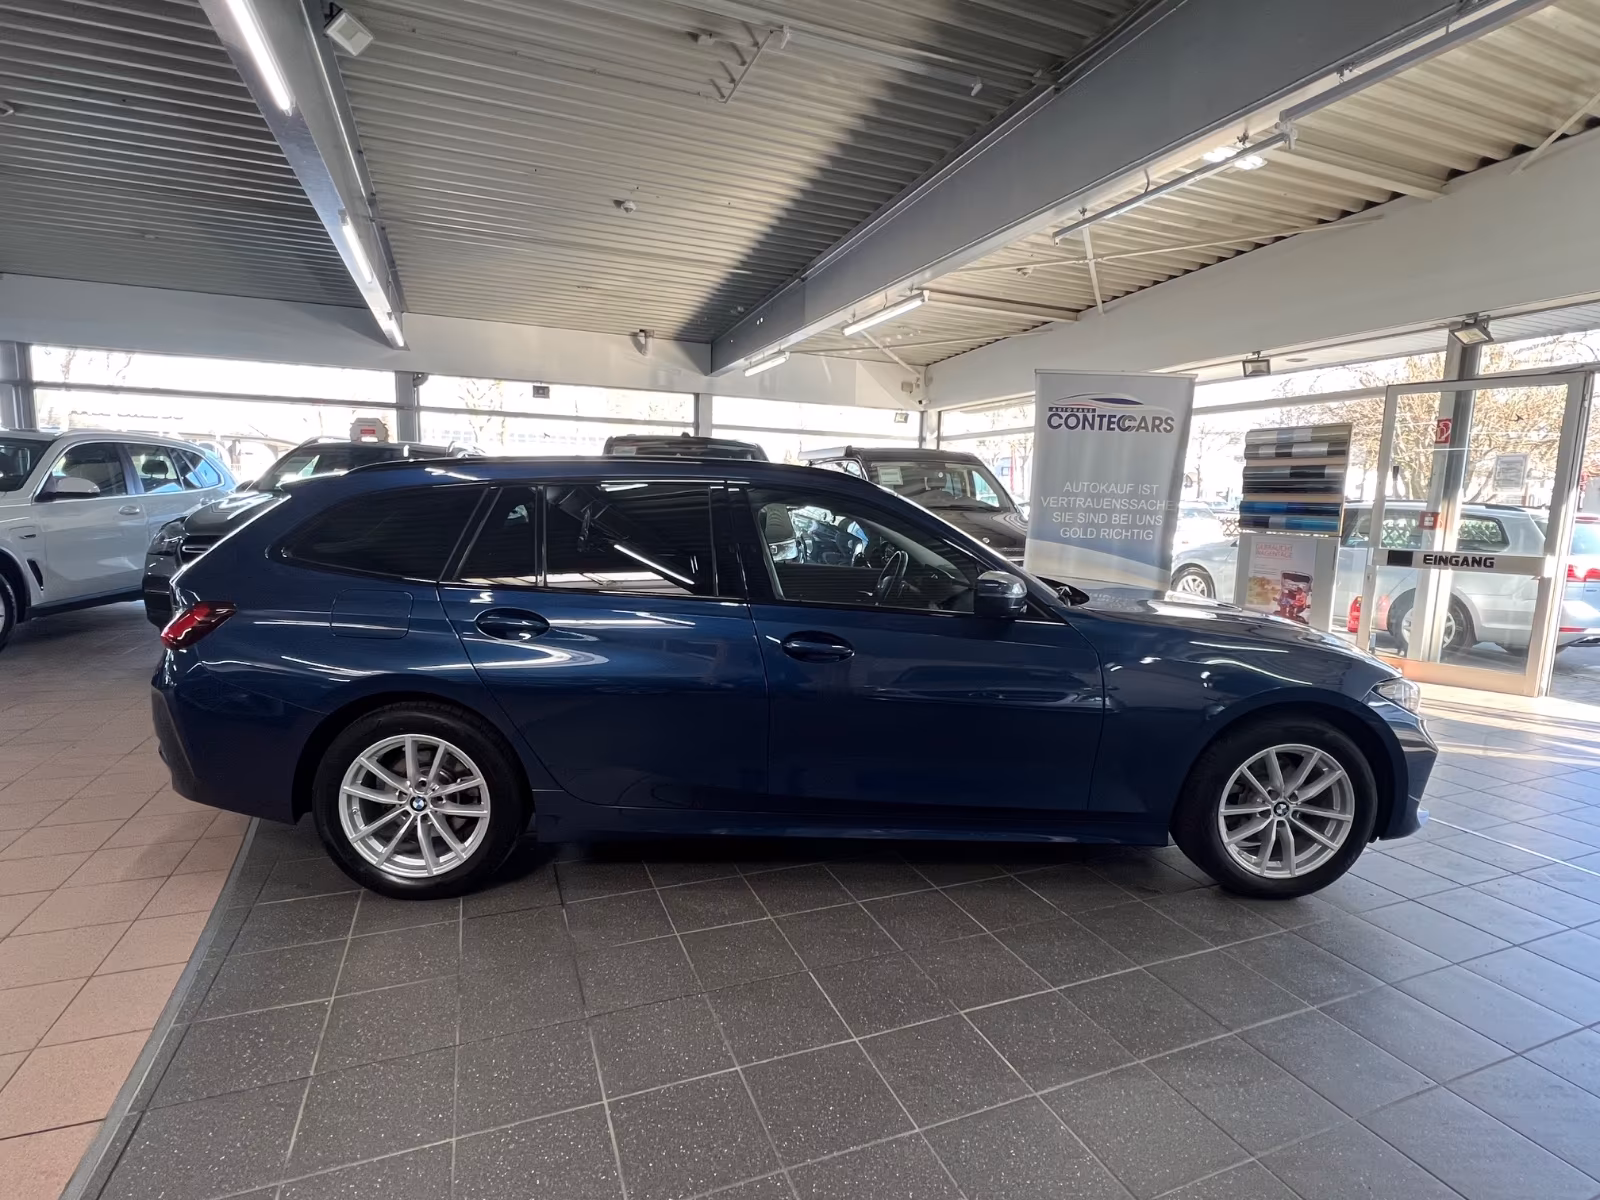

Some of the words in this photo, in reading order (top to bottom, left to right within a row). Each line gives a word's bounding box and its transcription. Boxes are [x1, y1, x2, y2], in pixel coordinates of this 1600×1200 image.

[1063, 481, 1135, 494] AUTOKAUF
[1138, 483, 1159, 495] IST
[1052, 511, 1074, 523] SIE
[1077, 512, 1108, 524] SIND
[1111, 513, 1132, 525] BEI
[1136, 514, 1163, 526] UNS
[1060, 527, 1097, 539] GOLD
[1100, 528, 1154, 541] RICHTIG
[1423, 554, 1495, 569] EINGANG
